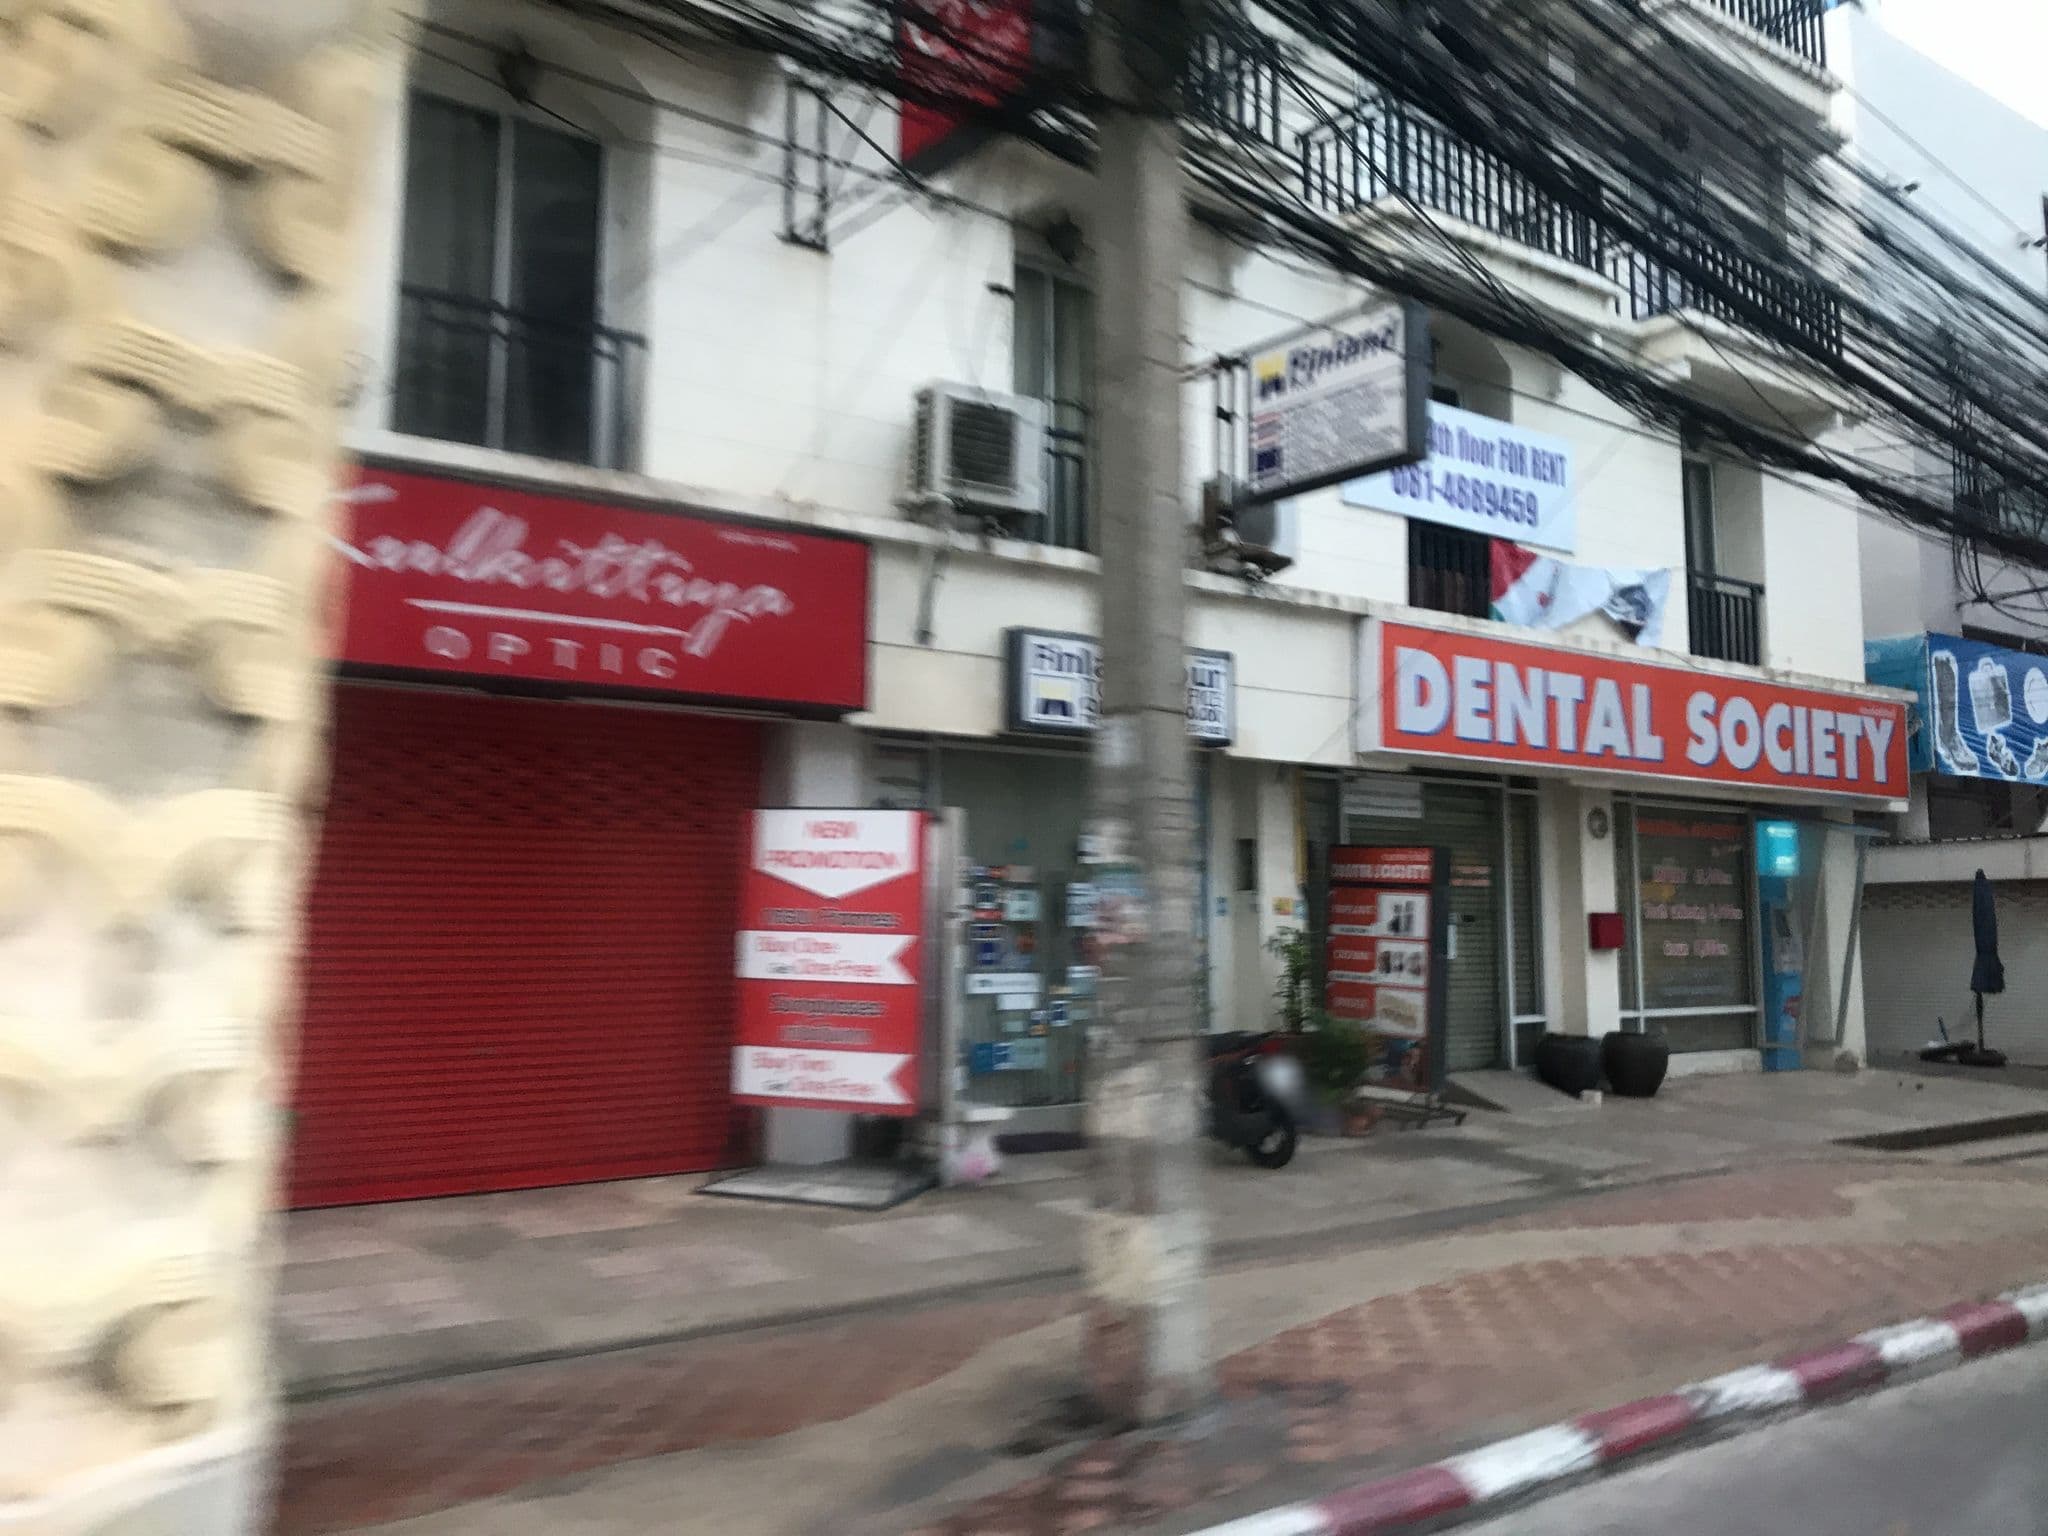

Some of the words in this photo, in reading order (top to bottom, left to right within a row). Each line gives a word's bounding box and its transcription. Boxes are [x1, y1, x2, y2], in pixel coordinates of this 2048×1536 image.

[1498, 436, 1528, 478] FOR
[1530, 446, 1568, 487] RENT
[423, 624, 678, 680] OPTIC
[1394, 646, 1664, 762] DENTAL
[1686, 691, 1896, 785] SOCIETY
